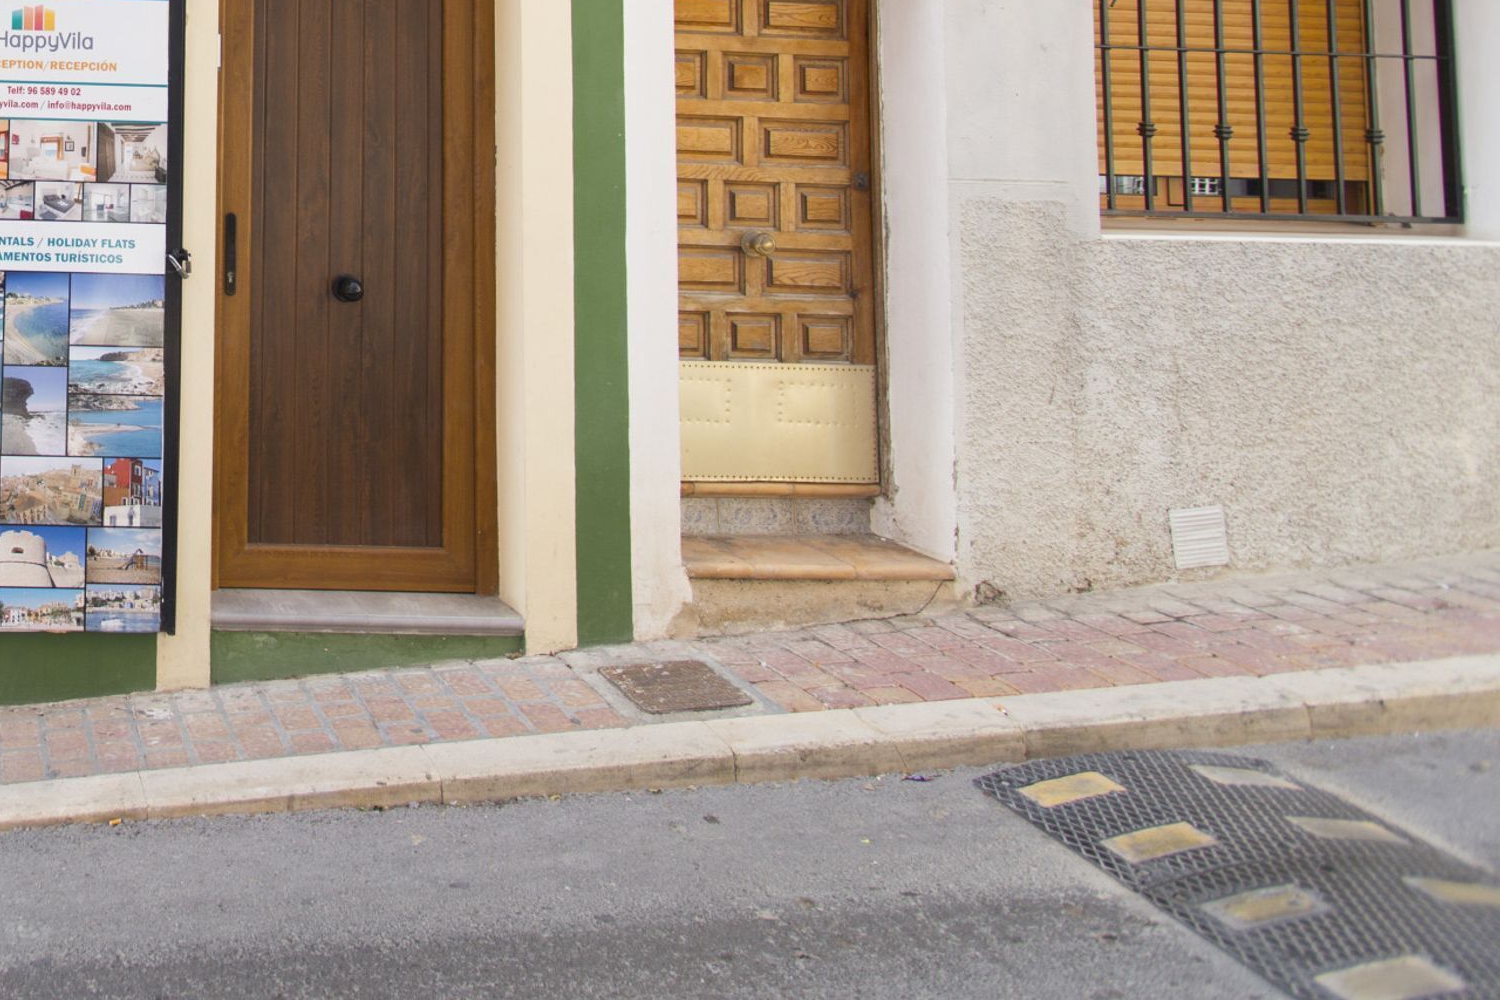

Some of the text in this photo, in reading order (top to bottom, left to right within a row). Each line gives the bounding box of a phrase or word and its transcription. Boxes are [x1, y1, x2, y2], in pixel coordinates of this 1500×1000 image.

[7, 85, 82, 97] Telf: 96 589 49 02
[47, 100, 132, 112] info@happyvila.com
[47, 237, 99, 249] HOLIDAY
[101, 239, 136, 249] FLATS
[55, 250, 123, 264] TURÍSTICOS
